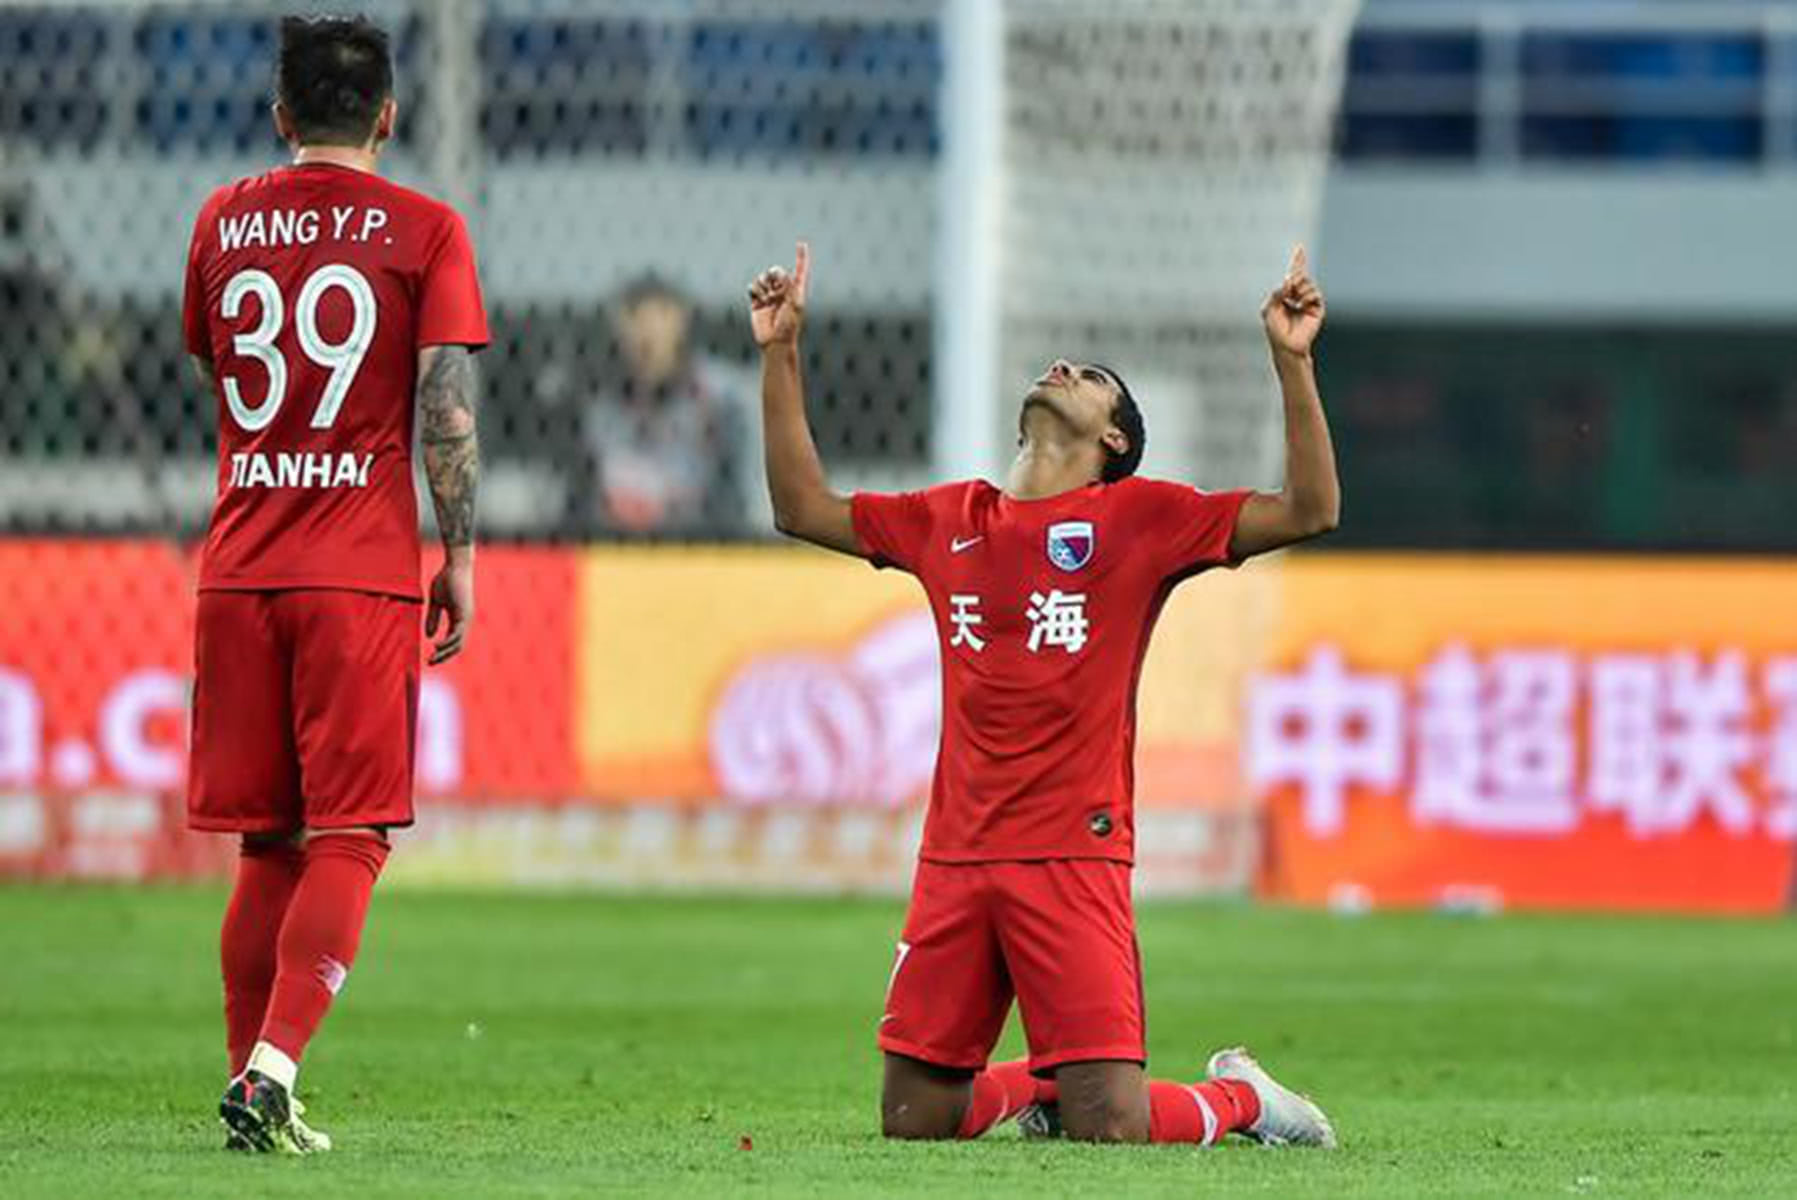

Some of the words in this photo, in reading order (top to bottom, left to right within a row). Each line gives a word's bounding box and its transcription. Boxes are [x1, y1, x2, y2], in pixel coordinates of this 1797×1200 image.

[218, 209, 320, 252] WANG
[331, 205, 393, 245] Y.P.
[220, 264, 377, 431] 39
